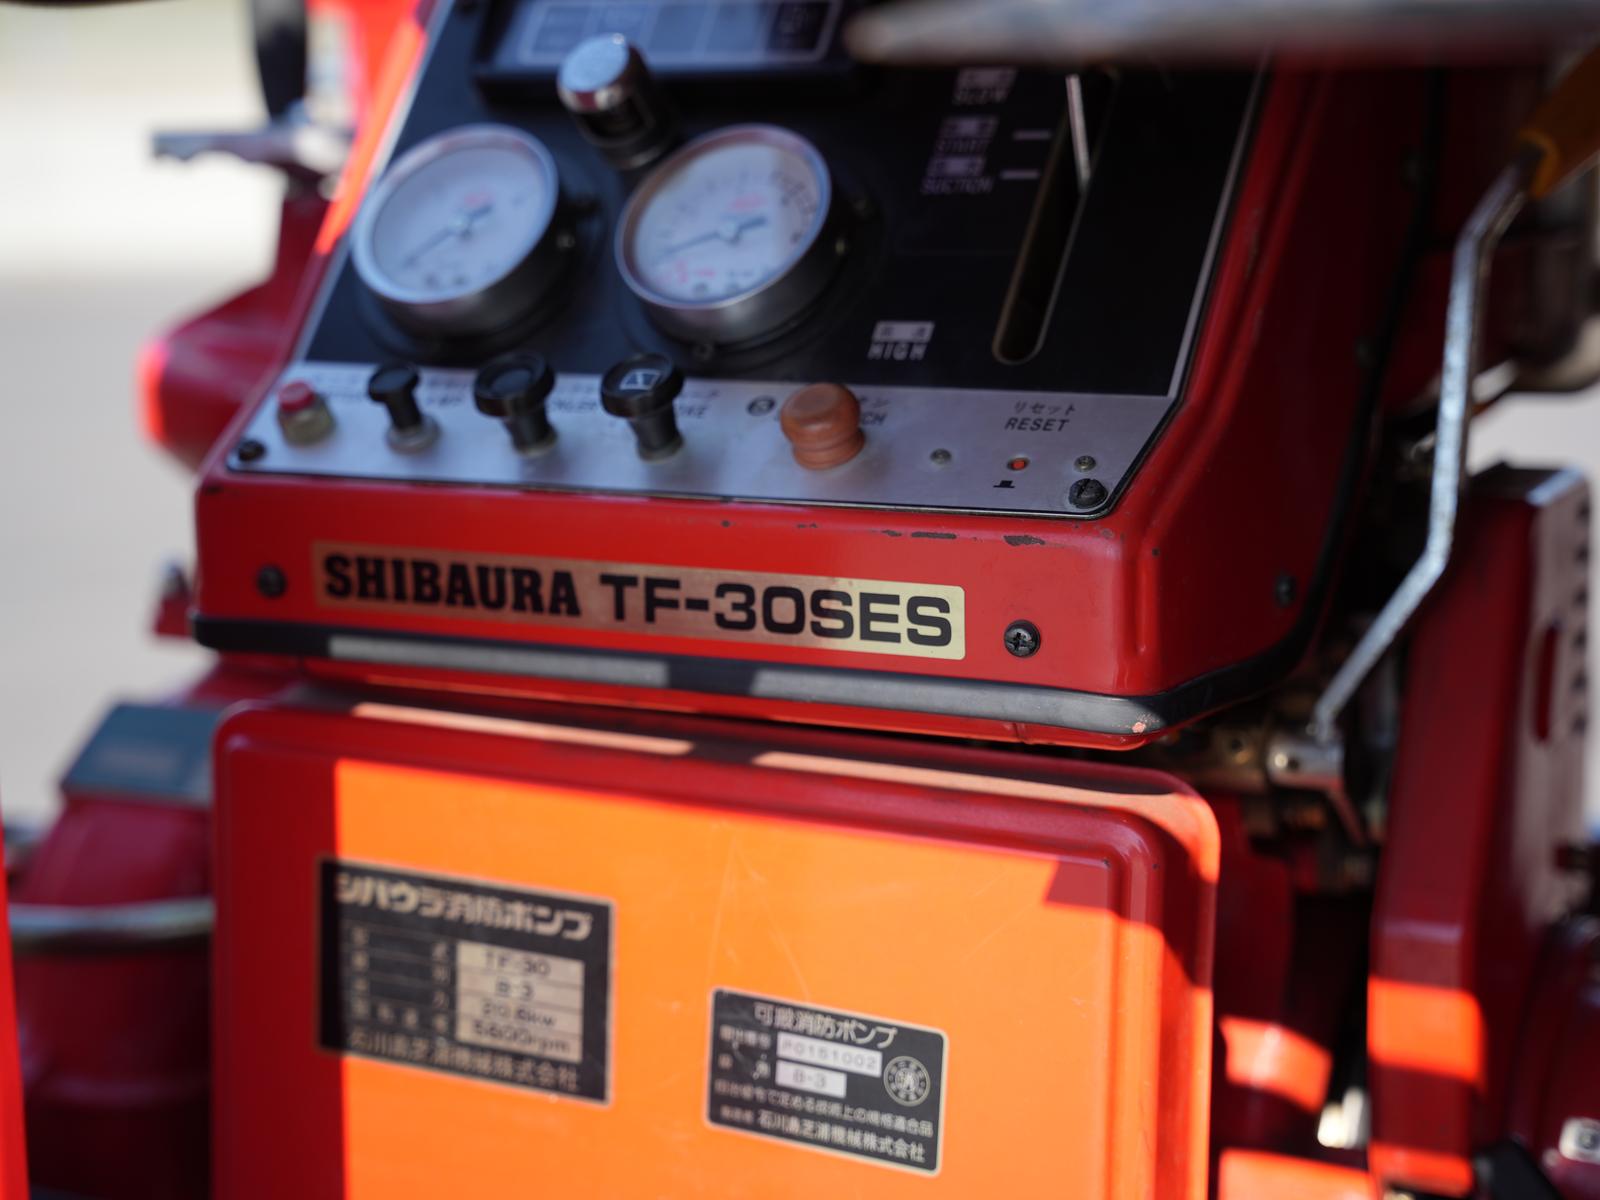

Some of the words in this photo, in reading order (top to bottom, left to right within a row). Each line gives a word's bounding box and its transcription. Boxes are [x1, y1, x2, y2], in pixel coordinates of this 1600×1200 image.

[867, 343, 928, 360] HIGH
[1014, 401, 1076, 416] リセット
[1004, 417, 1070, 432] RESET
[324, 553, 581, 616] SHIBAURA
[601, 573, 953, 647] TF-30SES
